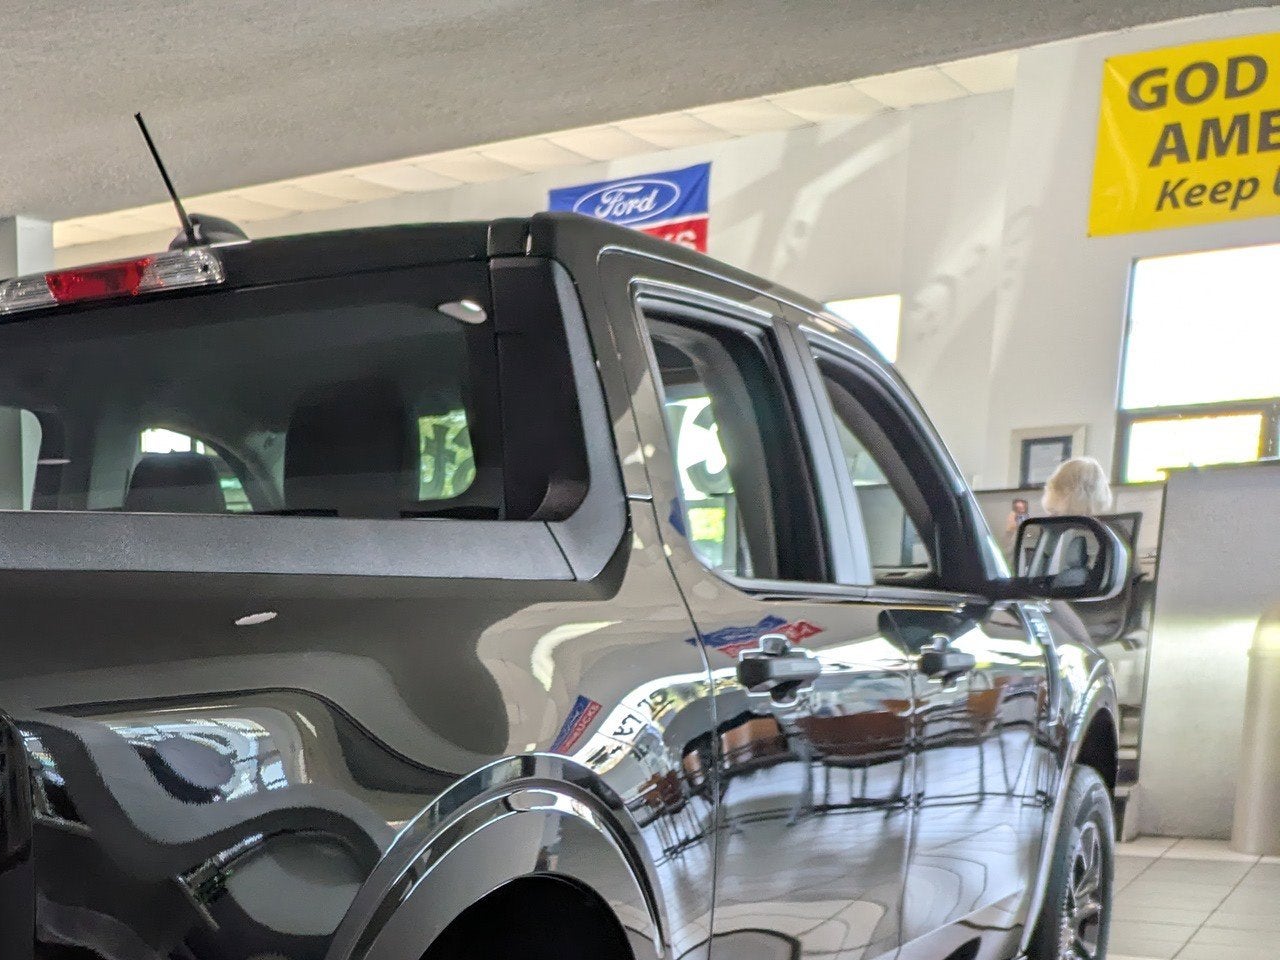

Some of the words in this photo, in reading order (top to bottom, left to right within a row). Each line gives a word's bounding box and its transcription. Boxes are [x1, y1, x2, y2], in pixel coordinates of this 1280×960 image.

[1127, 54, 1269, 112] GOD
[1147, 109, 1280, 168] AME
[594, 185, 660, 218] Ford
[1155, 176, 1260, 211] Keep
